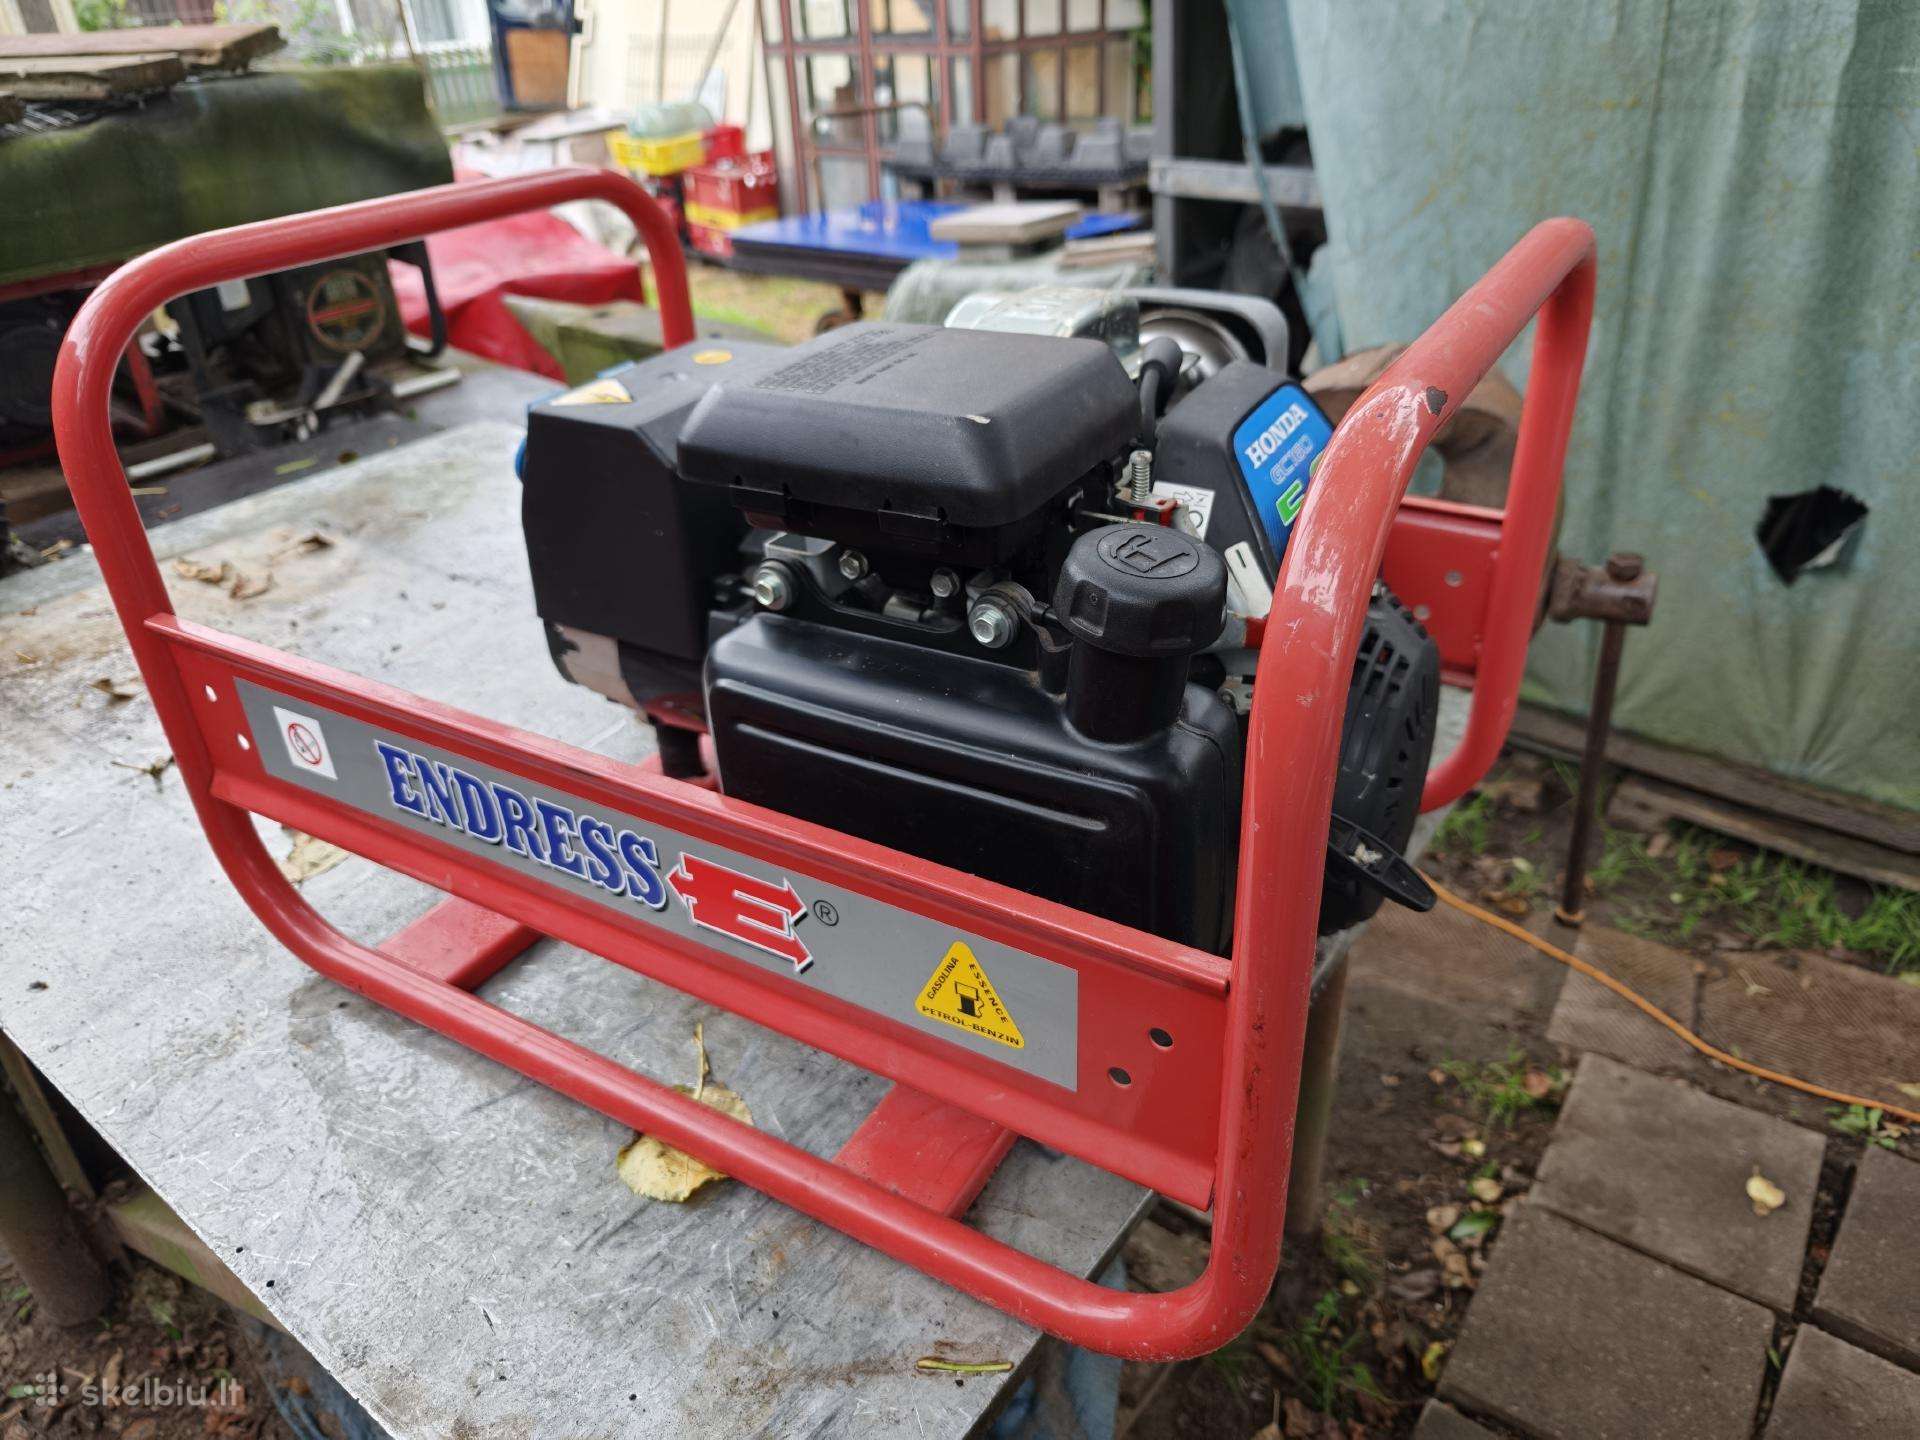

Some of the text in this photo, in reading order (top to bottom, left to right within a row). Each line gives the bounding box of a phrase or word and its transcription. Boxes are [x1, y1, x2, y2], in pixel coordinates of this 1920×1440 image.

[1244, 403, 1309, 469] HONDA
[374, 739, 668, 911] ENDRESS
[926, 956, 960, 1000] GASOLINA
[968, 962, 1009, 1024] ESSENCE
[921, 1005, 1020, 1046] PETROL-BENZIN
